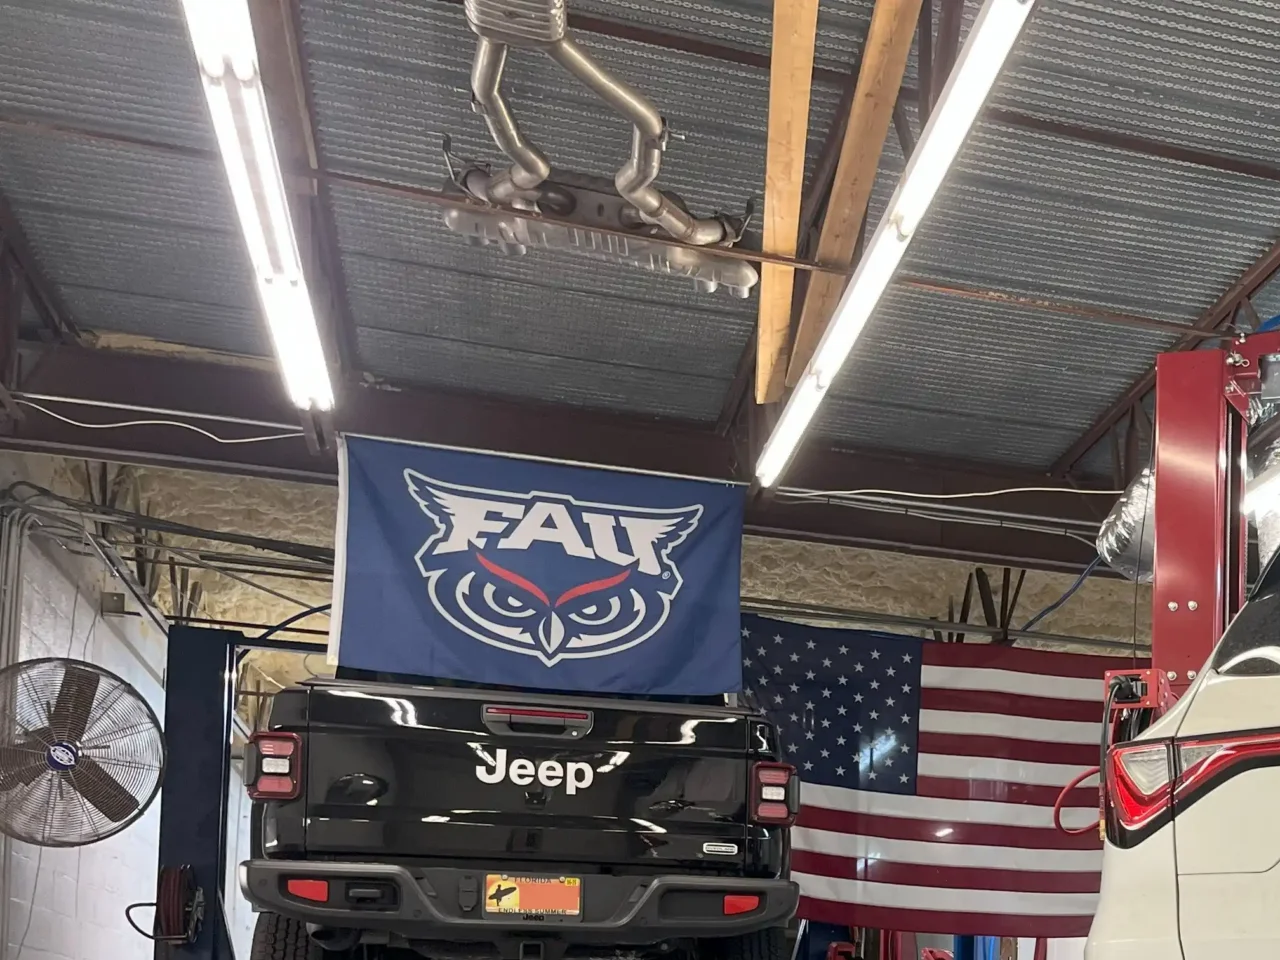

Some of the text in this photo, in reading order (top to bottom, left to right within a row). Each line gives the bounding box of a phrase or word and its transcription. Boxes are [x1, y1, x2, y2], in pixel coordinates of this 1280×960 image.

[424, 486, 684, 576] FAU
[475, 749, 594, 795] Jeep
[514, 876, 552, 884] FLORIDA
[522, 913, 545, 921] Jeep
